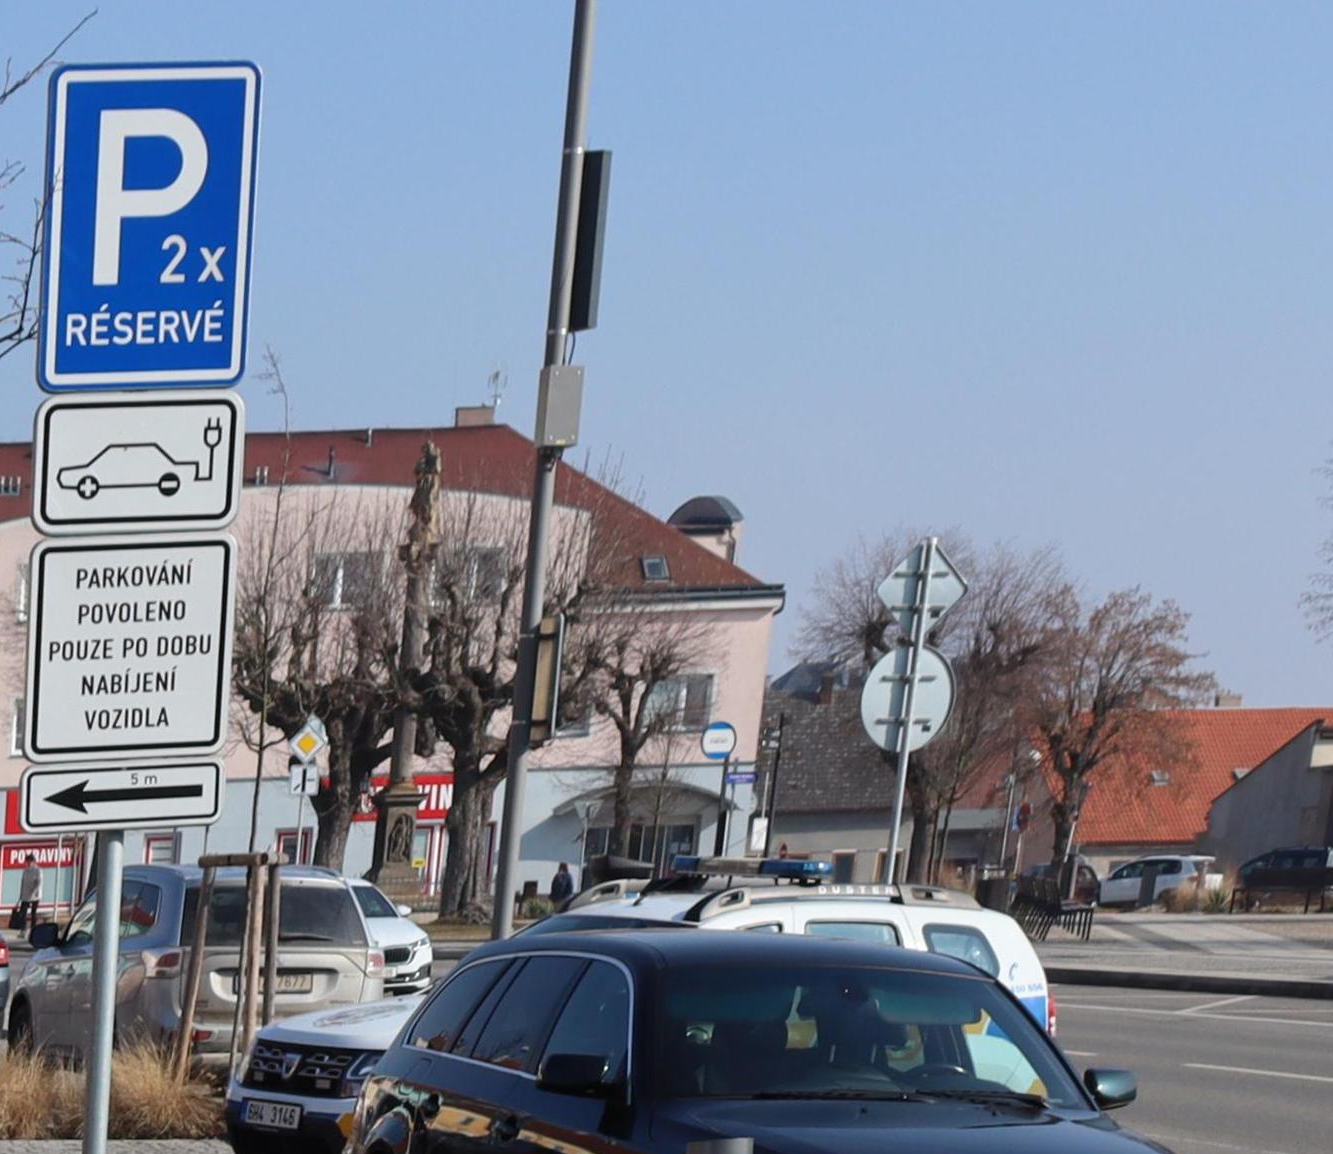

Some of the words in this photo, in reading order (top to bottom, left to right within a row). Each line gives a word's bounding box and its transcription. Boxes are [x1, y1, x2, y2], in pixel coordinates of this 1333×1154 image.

[92, 107, 209, 287] P
[159, 234, 188, 284] 2
[65, 300, 225, 347] RÉSERVÉ
[76, 559, 193, 590] PARKOVÁNÍ
[78, 600, 186, 625] POVOLENO
[48, 638, 114, 662] POUZE
[122, 637, 148, 659] PO
[157, 634, 212, 657] DOBU
[81, 666, 178, 696] NABÍJENÍ
[85, 707, 170, 731] VOZIDLA
[130, 773, 139, 786] 5
[144, 775, 158, 785] m
[818, 885, 895, 896] DUSTER
